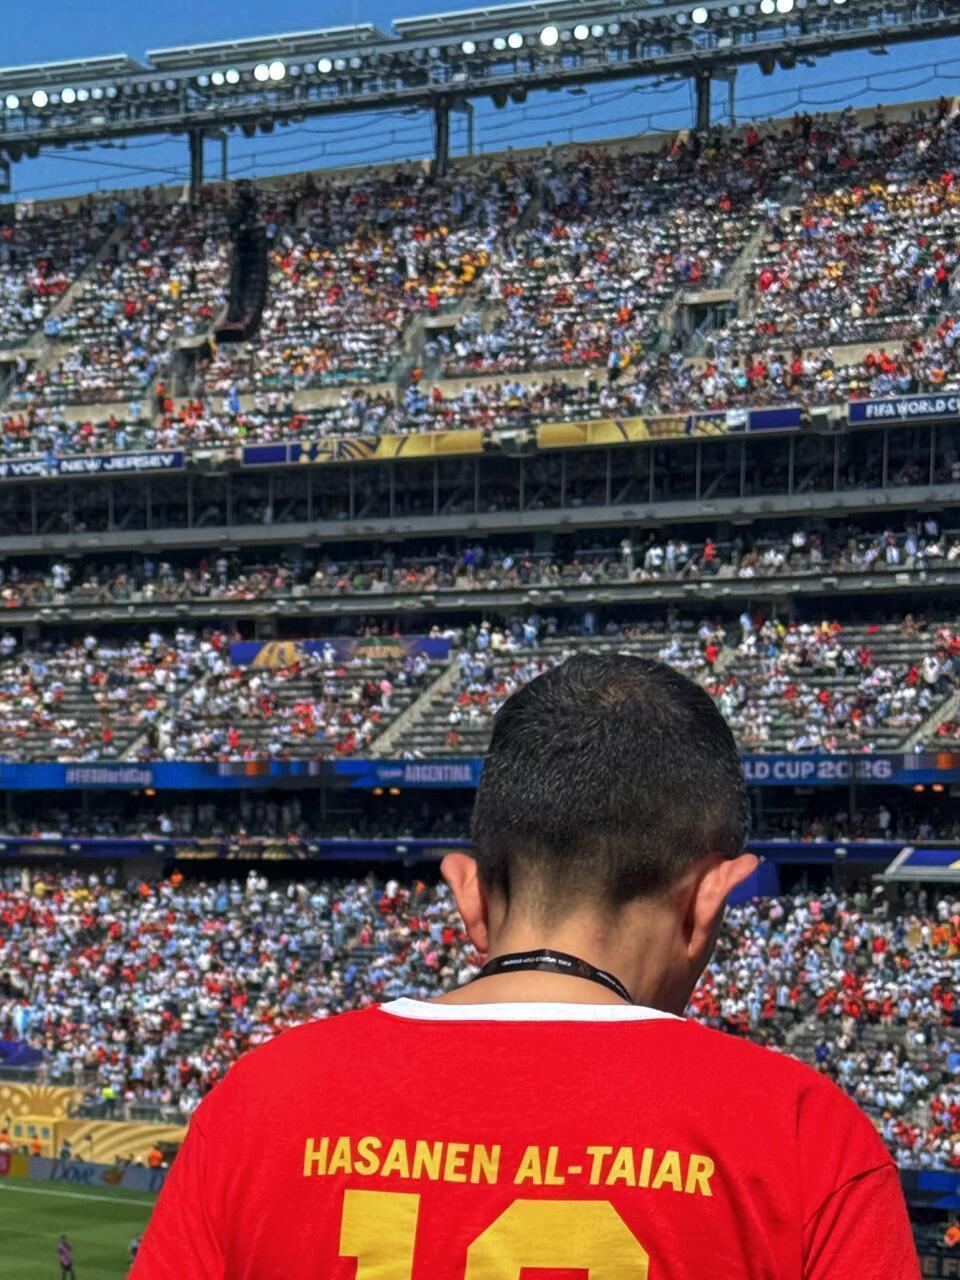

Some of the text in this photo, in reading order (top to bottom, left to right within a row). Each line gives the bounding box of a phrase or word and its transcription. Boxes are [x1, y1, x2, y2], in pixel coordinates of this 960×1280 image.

[865, 403, 895, 418] FIFA
[896, 399, 945, 416] WORLD
[60, 459, 101, 472] NEW
[103, 454, 175, 471] JERSEY
[773, 761, 814, 779] CUP
[817, 759, 891, 779] 2026
[50, 1159, 95, 1184] Dove
[303, 1136, 715, 1197] HASANEN AL-TAIAR
